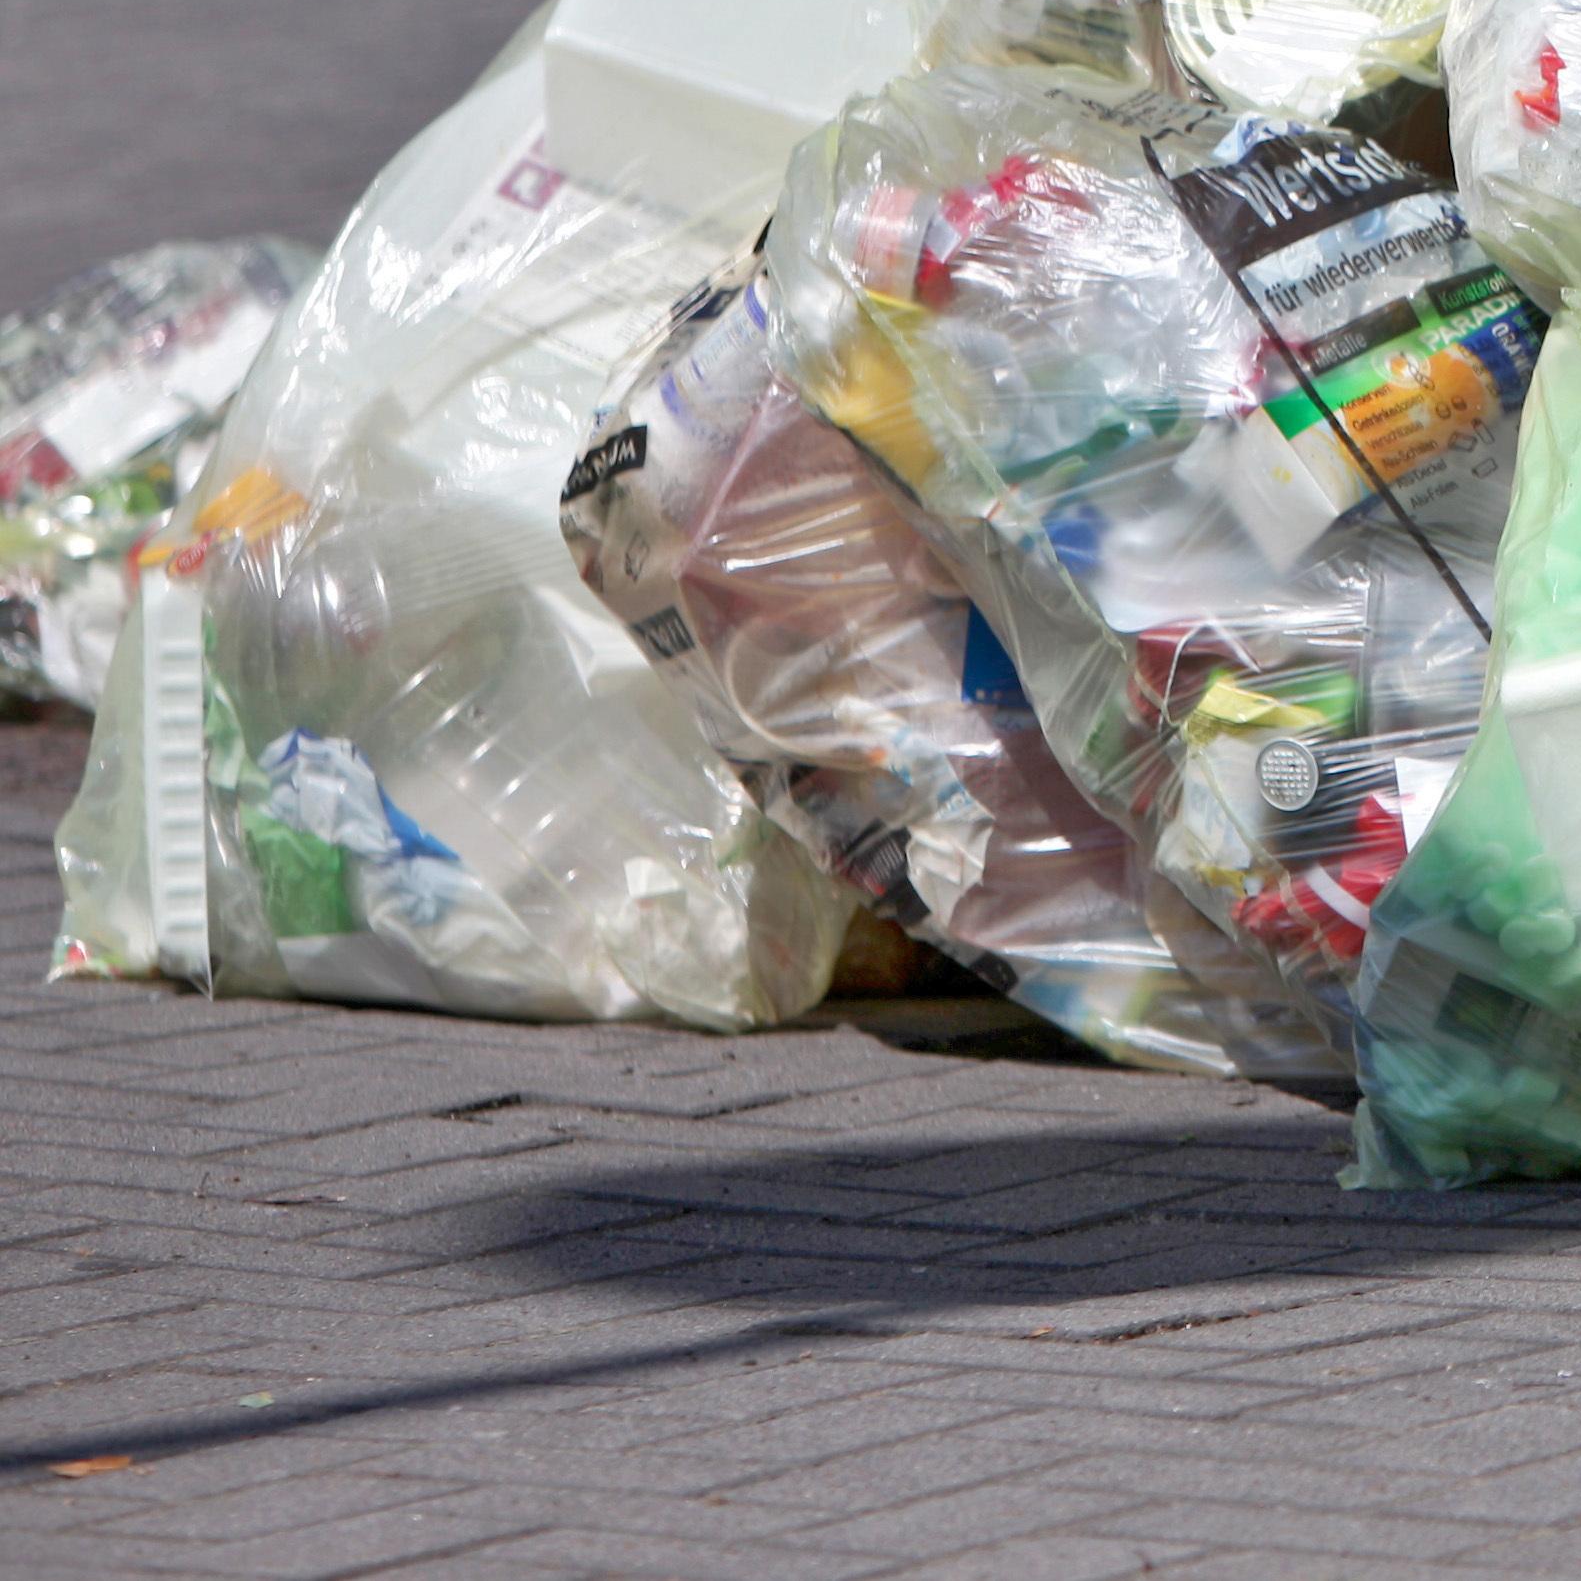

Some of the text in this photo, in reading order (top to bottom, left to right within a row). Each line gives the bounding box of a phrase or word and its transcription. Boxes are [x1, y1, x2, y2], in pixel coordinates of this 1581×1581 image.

[1264, 205, 1472, 317] für wiederverwertba
[1314, 330, 1368, 370] Metalle
